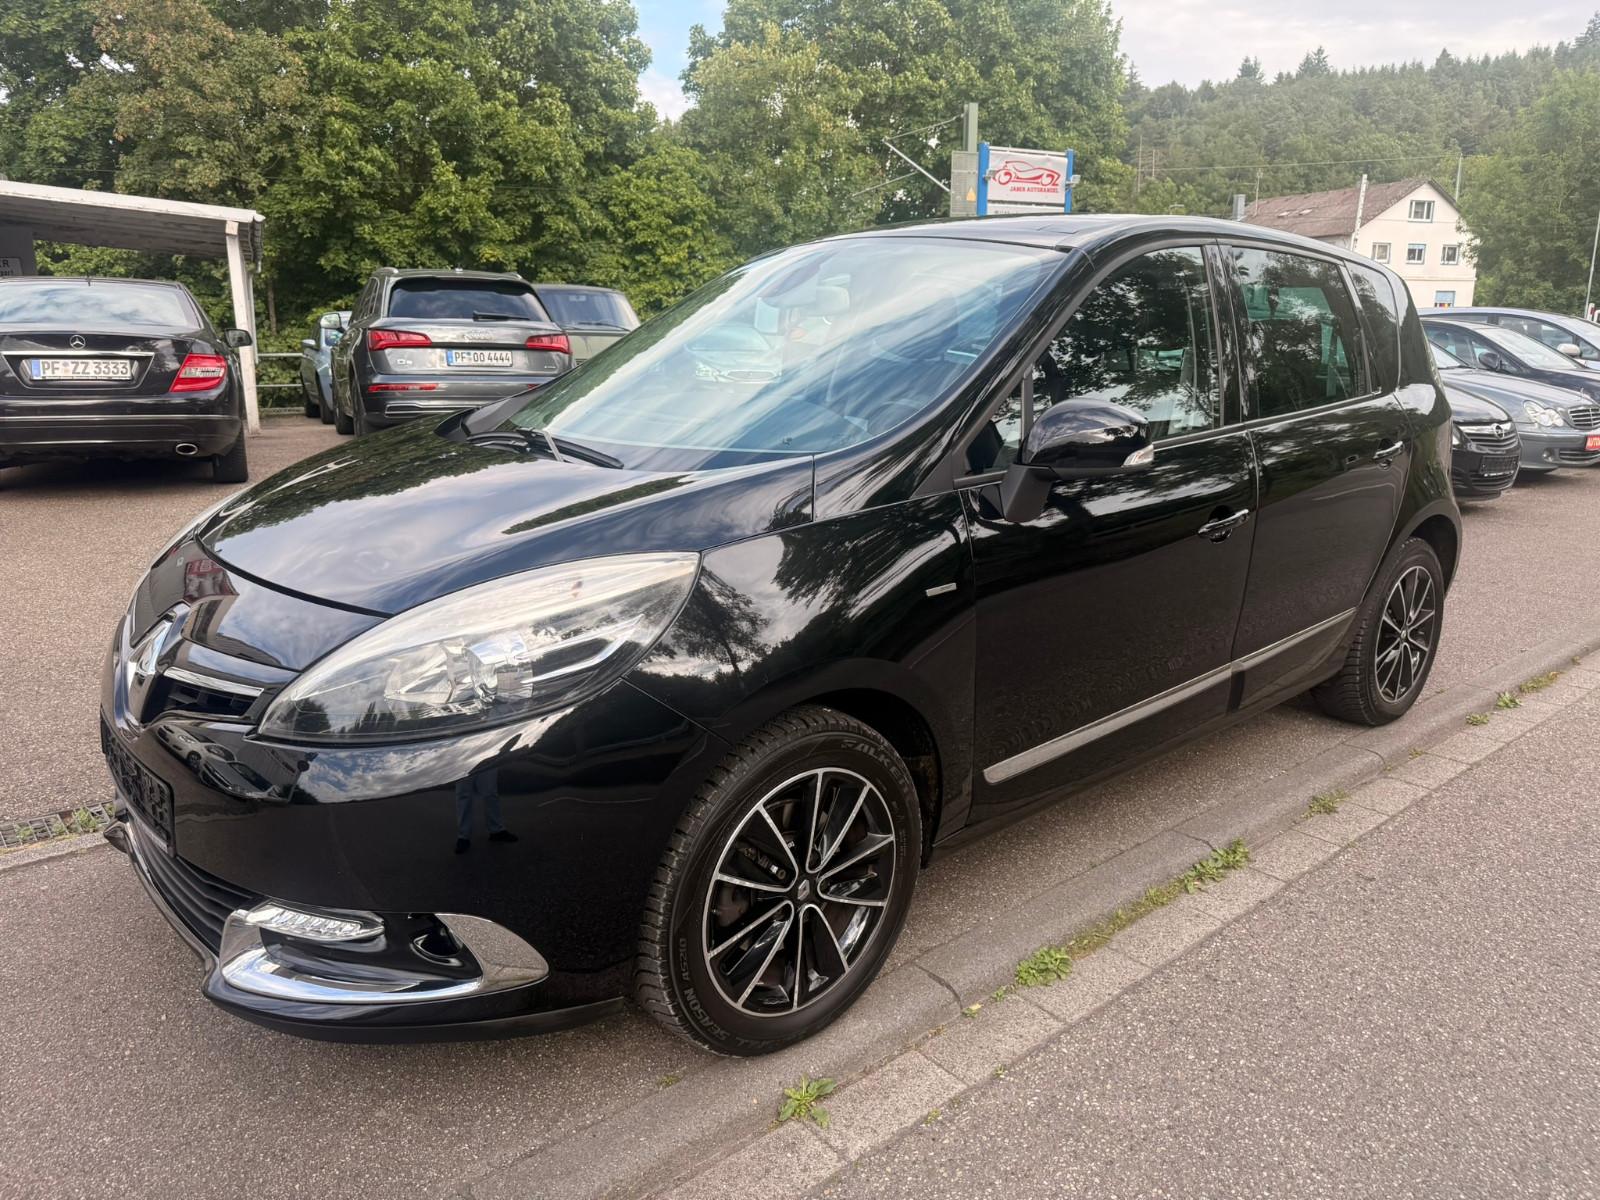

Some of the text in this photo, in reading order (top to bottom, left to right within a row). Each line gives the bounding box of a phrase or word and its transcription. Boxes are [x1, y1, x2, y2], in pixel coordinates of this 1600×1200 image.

[454, 351, 466, 362] PF
[487, 353, 511, 363] 4444
[41, 361, 129, 375] PF ZZ 3333
[683, 987, 730, 1041] SEASON
